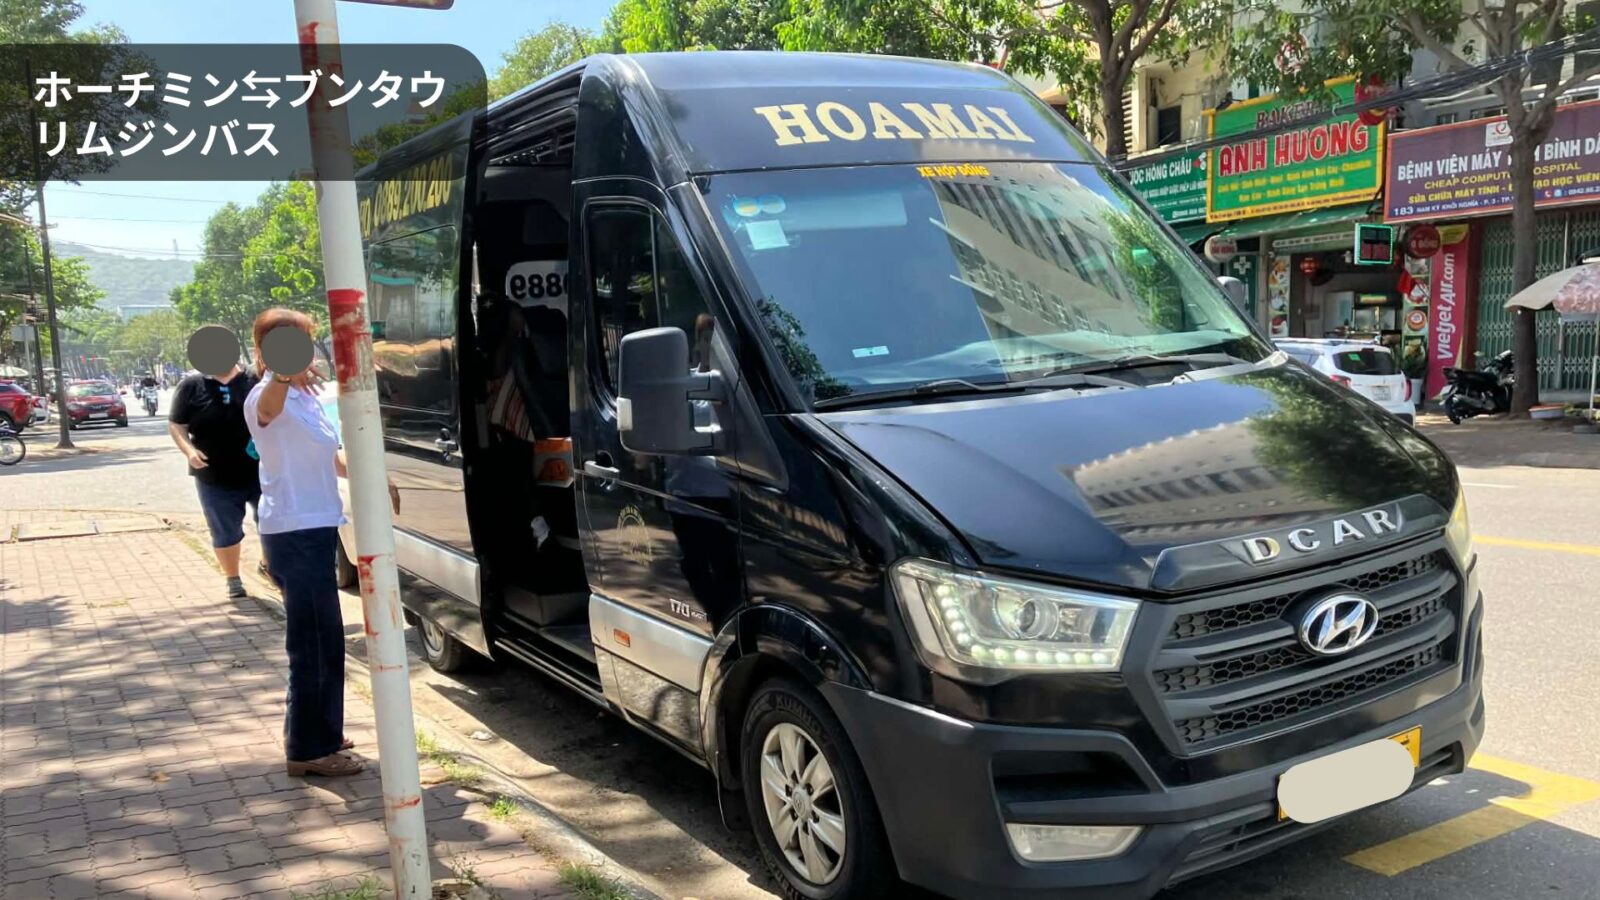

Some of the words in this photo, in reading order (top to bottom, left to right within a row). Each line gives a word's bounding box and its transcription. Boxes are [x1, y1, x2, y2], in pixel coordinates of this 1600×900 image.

[754, 100, 1036, 146] HOAMAI
[916, 165, 936, 177] XE
[934, 164, 957, 179] HỢP
[957, 163, 990, 177] ĐỒNG
[1169, 157, 1192, 177] CHÂU
[1218, 138, 1268, 178] ANH
[1398, 160, 1433, 184] BỆNH
[1436, 153, 1468, 178] VIỆN
[1471, 147, 1502, 171] MÁY
[1544, 137, 1581, 161] BÌNH
[1408, 191, 1427, 204] SỬA
[1455, 187, 1475, 198] MÁY
[1478, 185, 1500, 196] TÍNH
[1552, 176, 1573, 188] HỌC
[1424, 177, 1460, 190] CHEAP
[1533, 161, 1582, 175] OSPITAL
[1394, 206, 1414, 216] 183
[1242, 508, 1399, 564] DCAR
